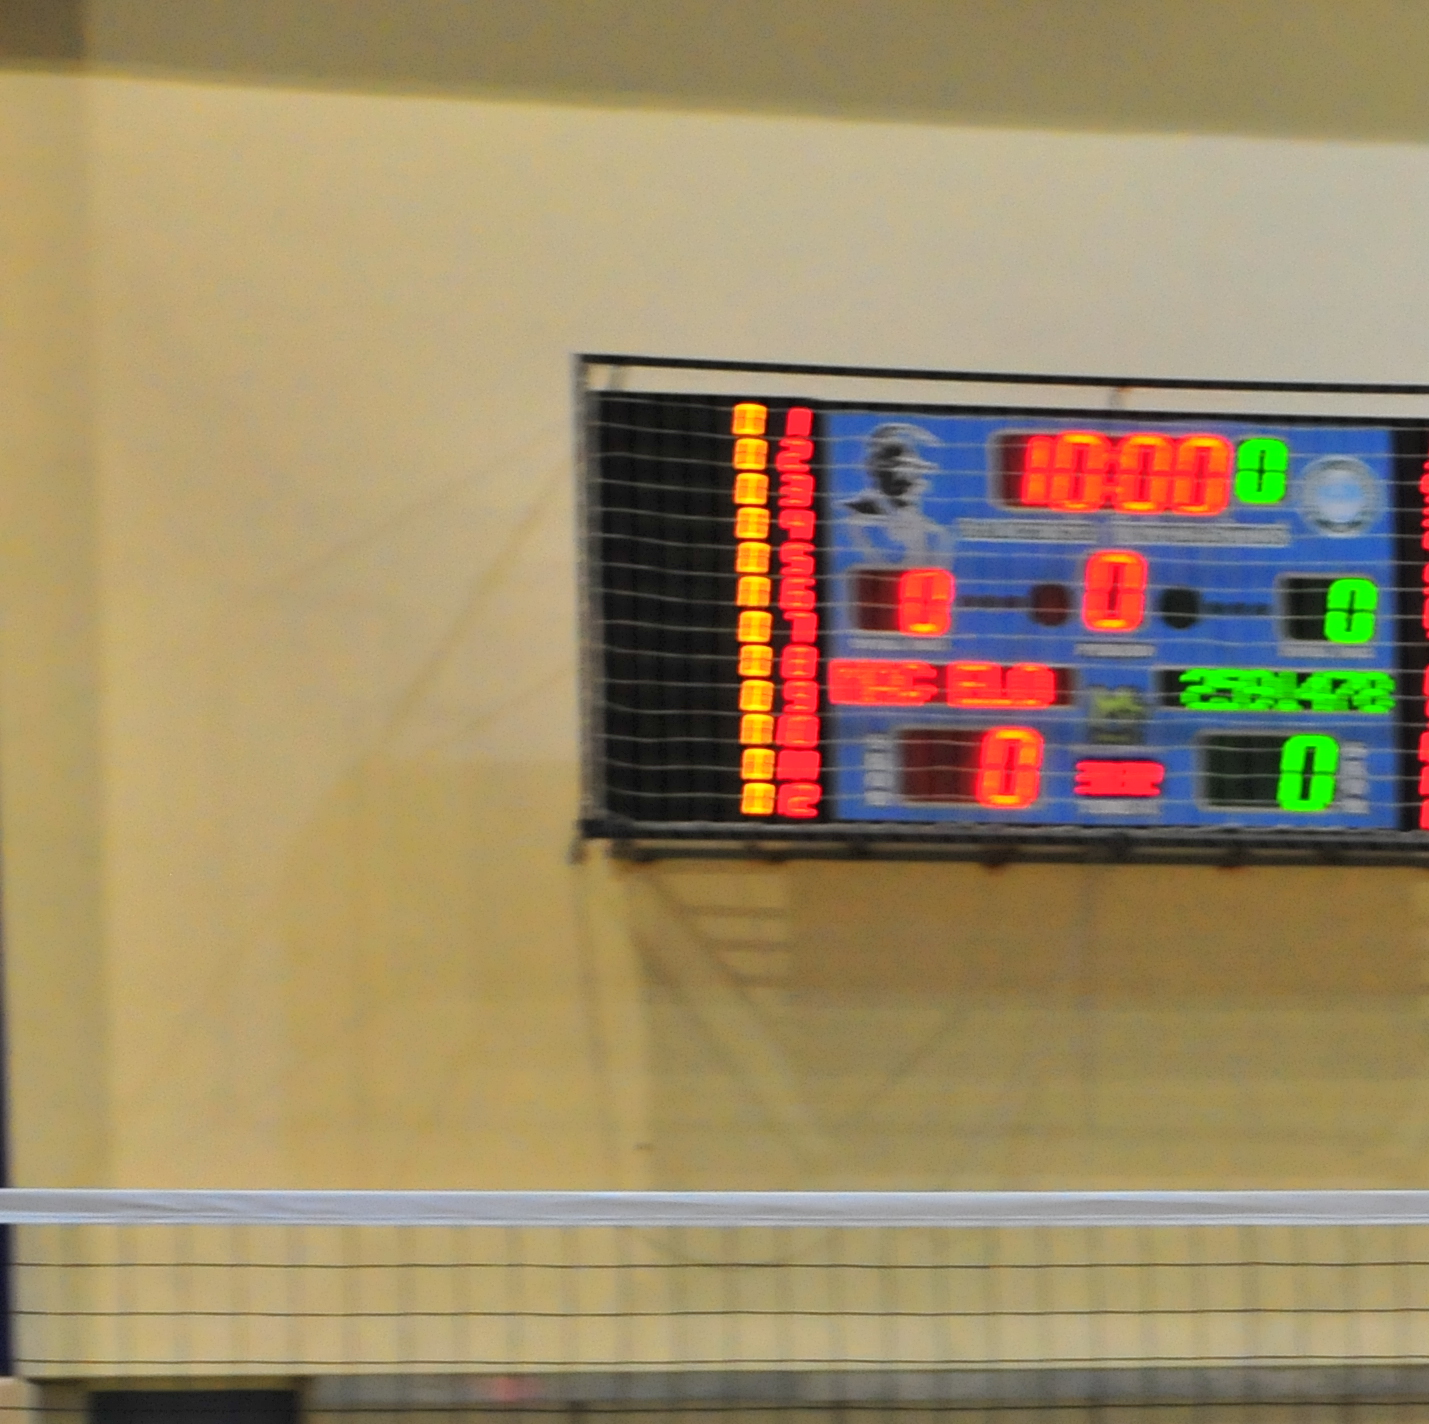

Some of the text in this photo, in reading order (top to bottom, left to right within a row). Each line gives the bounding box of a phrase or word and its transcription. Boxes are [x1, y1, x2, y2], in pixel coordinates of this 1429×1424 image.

[1021, 430, 1288, 516] 10:00 0
[1081, 550, 1149, 632] 0
[1324, 577, 1378, 644] 0
[974, 726, 1044, 809] 0
[1277, 734, 1339, 812] 0
